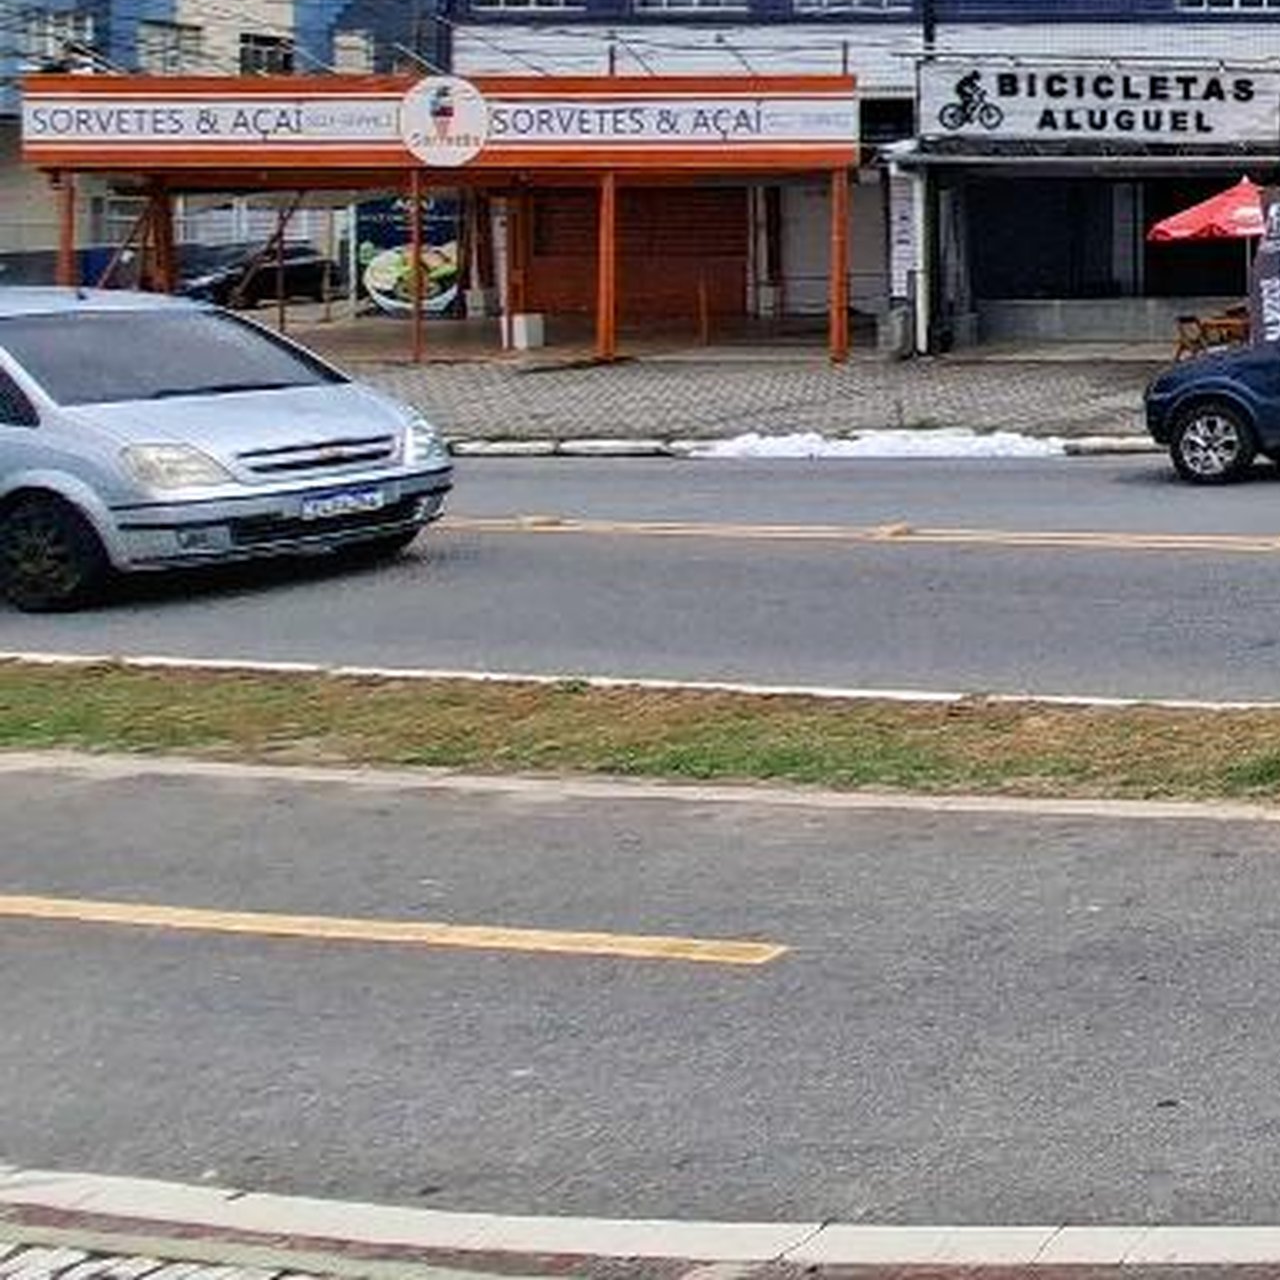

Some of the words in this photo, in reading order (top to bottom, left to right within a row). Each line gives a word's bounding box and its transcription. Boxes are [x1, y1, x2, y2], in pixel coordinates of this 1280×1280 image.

[996, 73, 1255, 102] BICICLETAS
[31, 108, 184, 135] SORVETES
[195, 108, 219, 135] &
[492, 107, 645, 135] SORVETES
[655, 107, 681, 135] &
[691, 100, 762, 141] AÇAÍ
[1036, 108, 1214, 133] ALUGUEL
